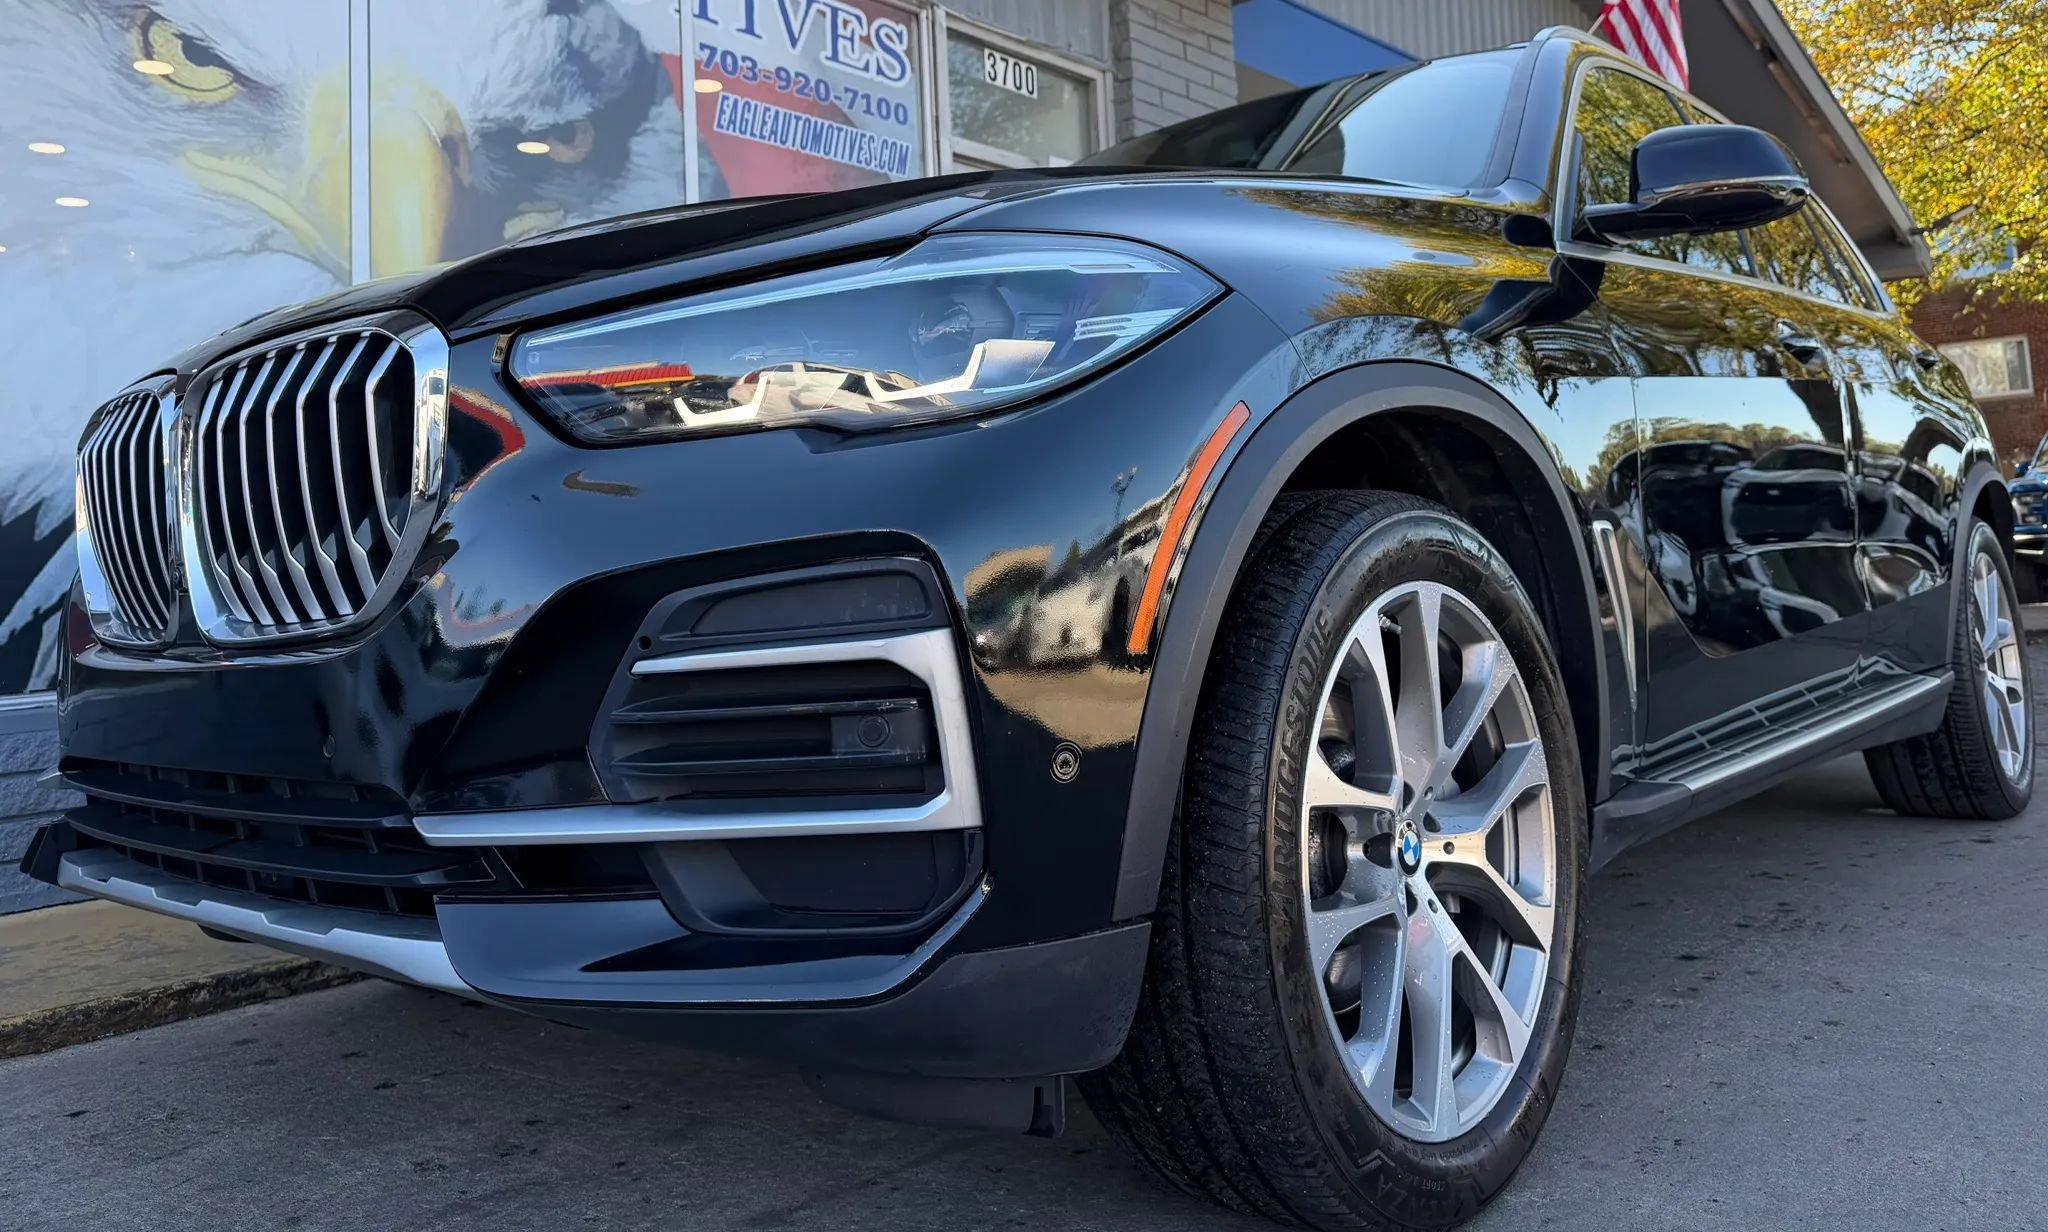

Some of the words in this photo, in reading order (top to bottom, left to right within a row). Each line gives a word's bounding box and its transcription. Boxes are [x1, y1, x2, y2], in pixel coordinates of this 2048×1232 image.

[699, 42, 909, 126] 703-920-7100
[987, 52, 1035, 95] 3700
[716, 95, 910, 175] EAGLEAUTOMOTIVES.COM
